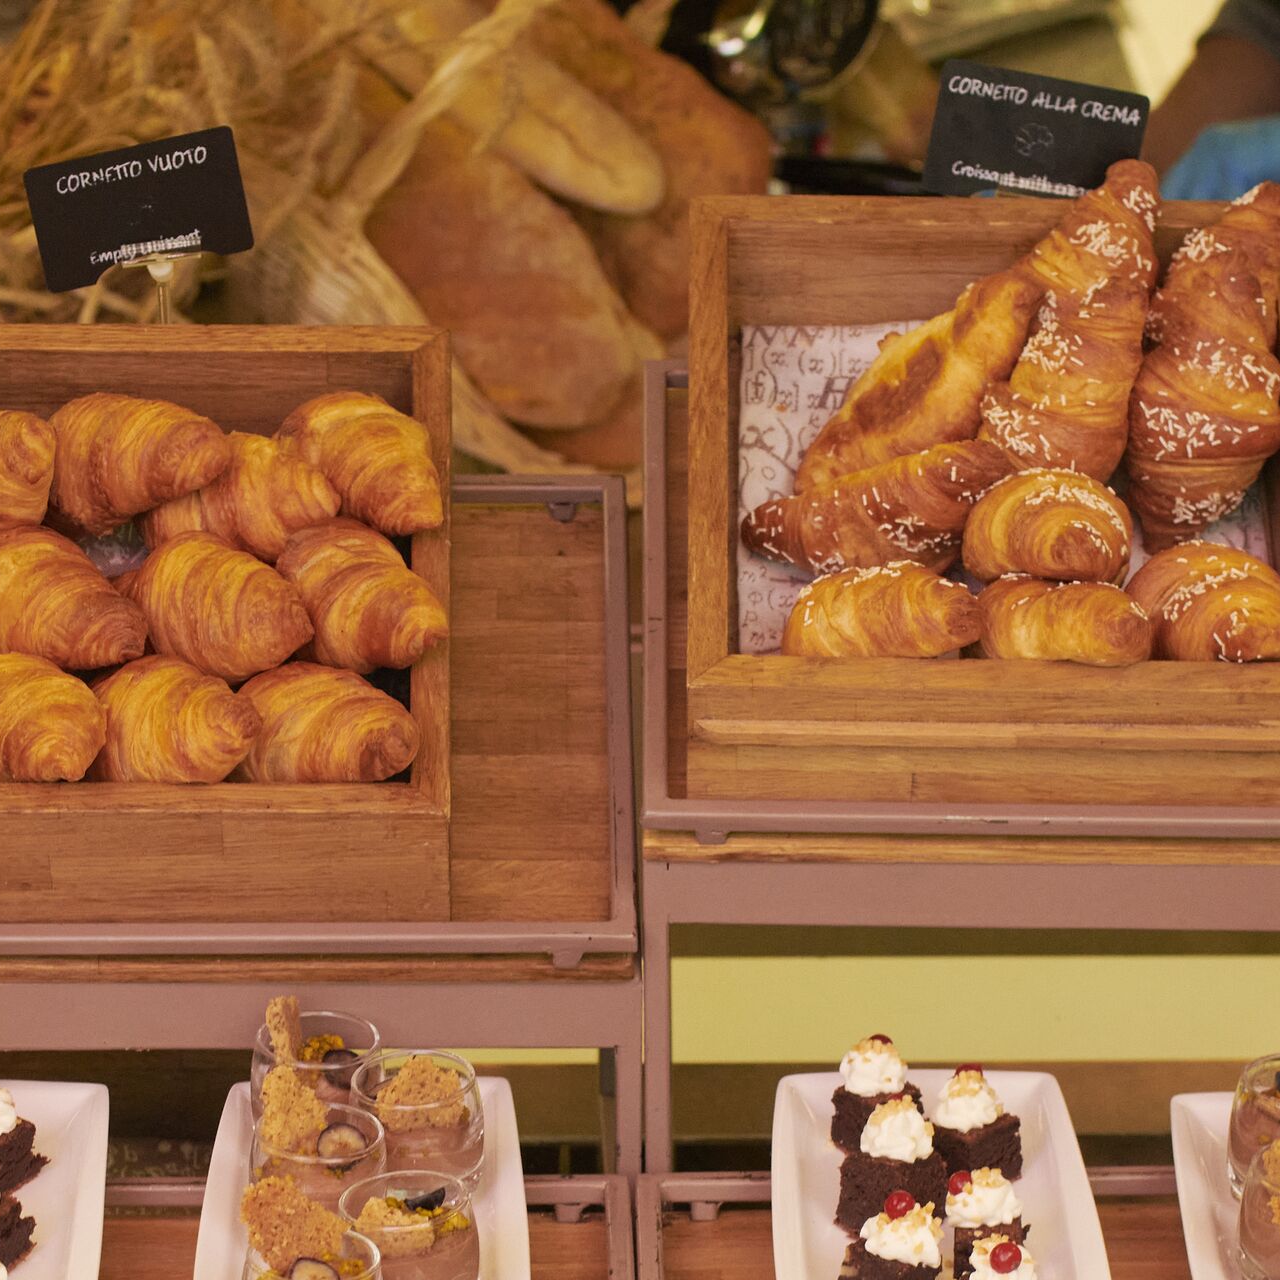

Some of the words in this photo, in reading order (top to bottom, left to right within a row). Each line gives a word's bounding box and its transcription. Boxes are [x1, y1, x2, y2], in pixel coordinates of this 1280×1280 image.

[949, 76, 1028, 104] CORNETTO
[1032, 92, 1077, 112] ALLA
[1081, 101, 1140, 125] CREMA
[57, 160, 142, 194] CORNETTO
[147, 147, 207, 173] VUOTO
